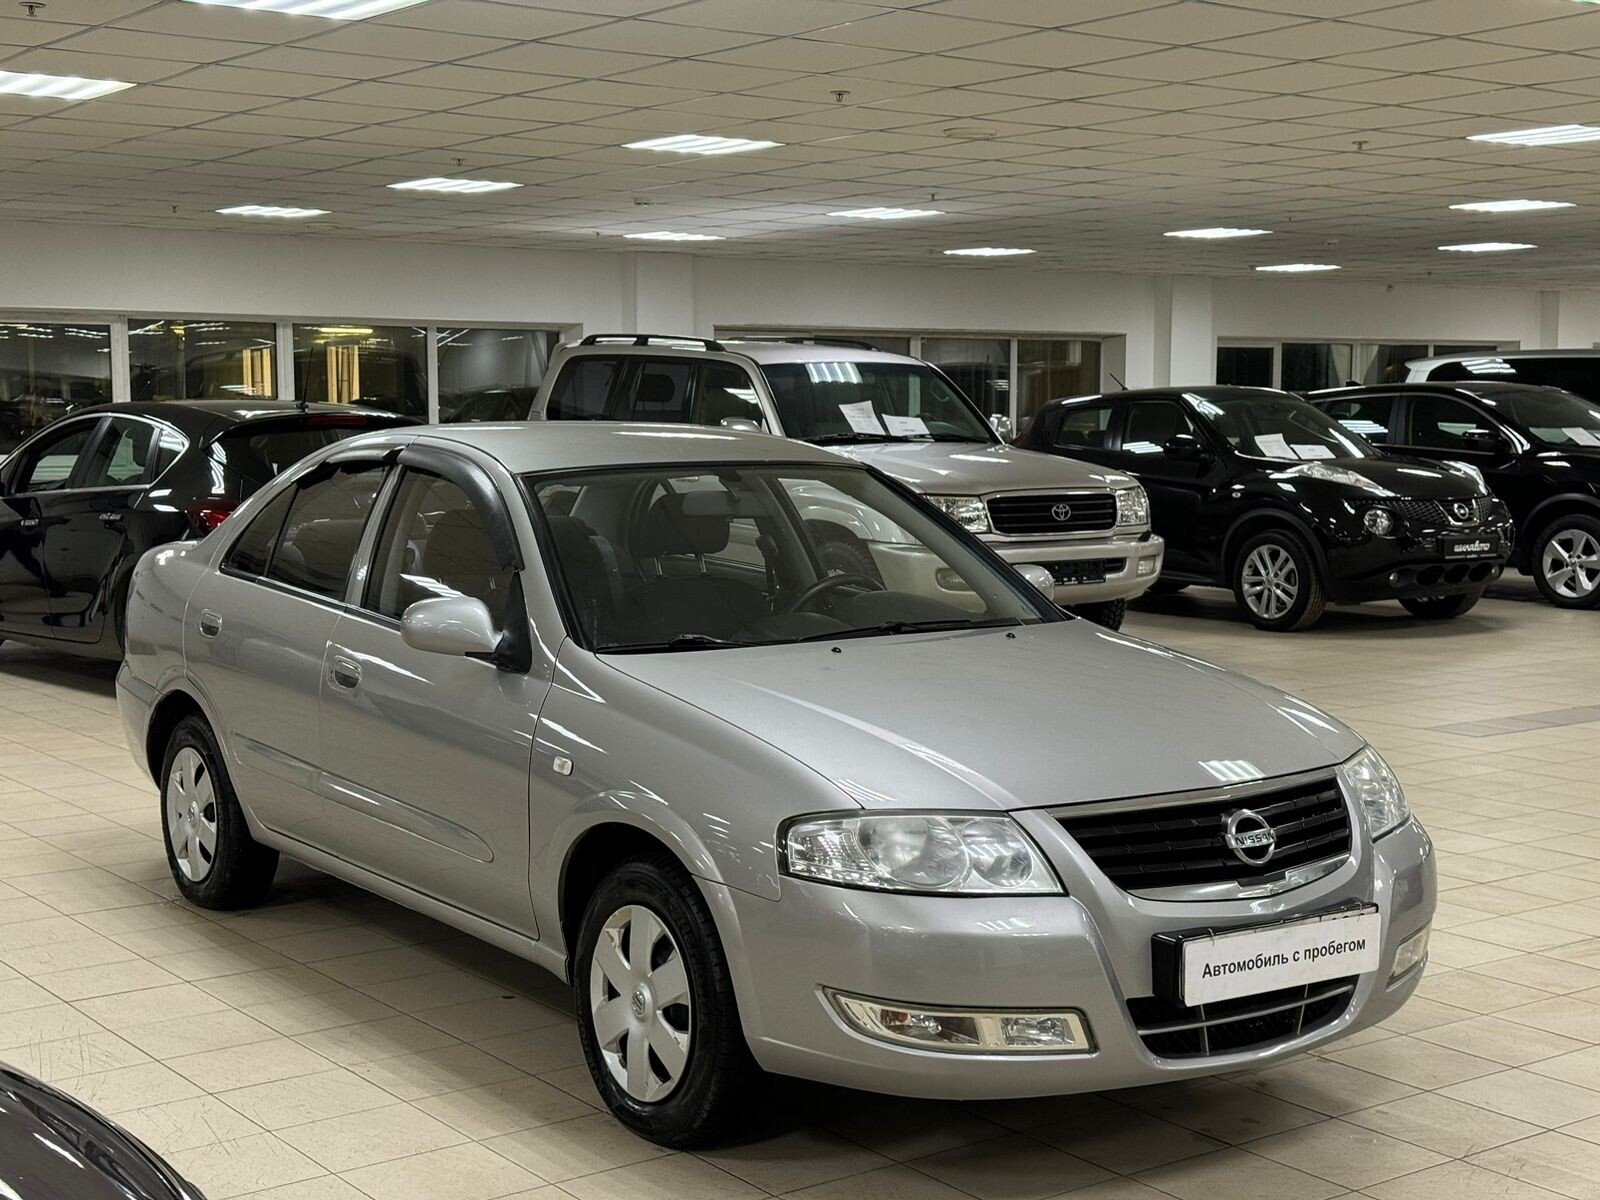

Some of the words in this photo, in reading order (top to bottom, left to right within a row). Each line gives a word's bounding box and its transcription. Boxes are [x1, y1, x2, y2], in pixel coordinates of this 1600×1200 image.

[1235, 832, 1274, 845] NISSAN
[1201, 953, 1289, 979] Автомобиль
[1292, 950, 1300, 962] с
[1304, 938, 1366, 962] пробегом
